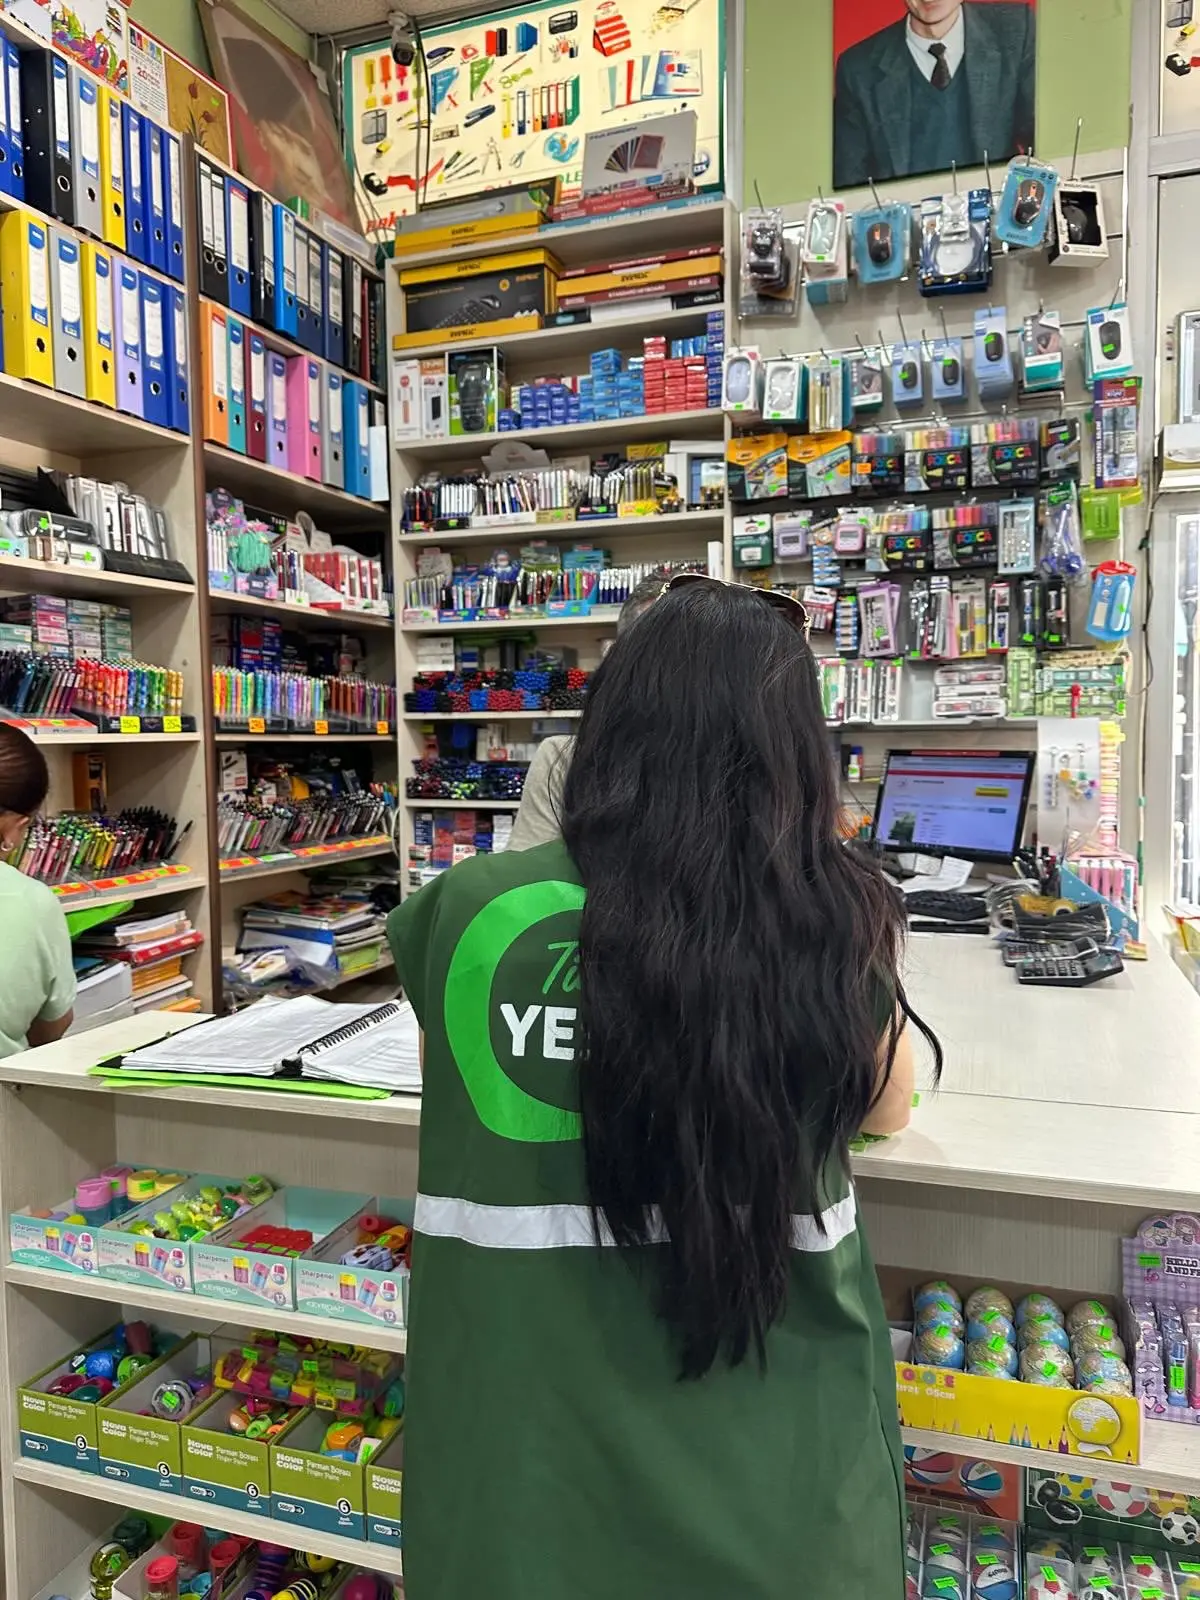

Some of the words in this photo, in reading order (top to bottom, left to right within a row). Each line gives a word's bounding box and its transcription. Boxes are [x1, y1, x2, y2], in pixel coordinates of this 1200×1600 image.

[1166, 1257, 1198, 1267] HELLO
[187, 1439, 213, 1450] Nova
[276, 1453, 303, 1465] Nova
[276, 1460, 303, 1471] Color
